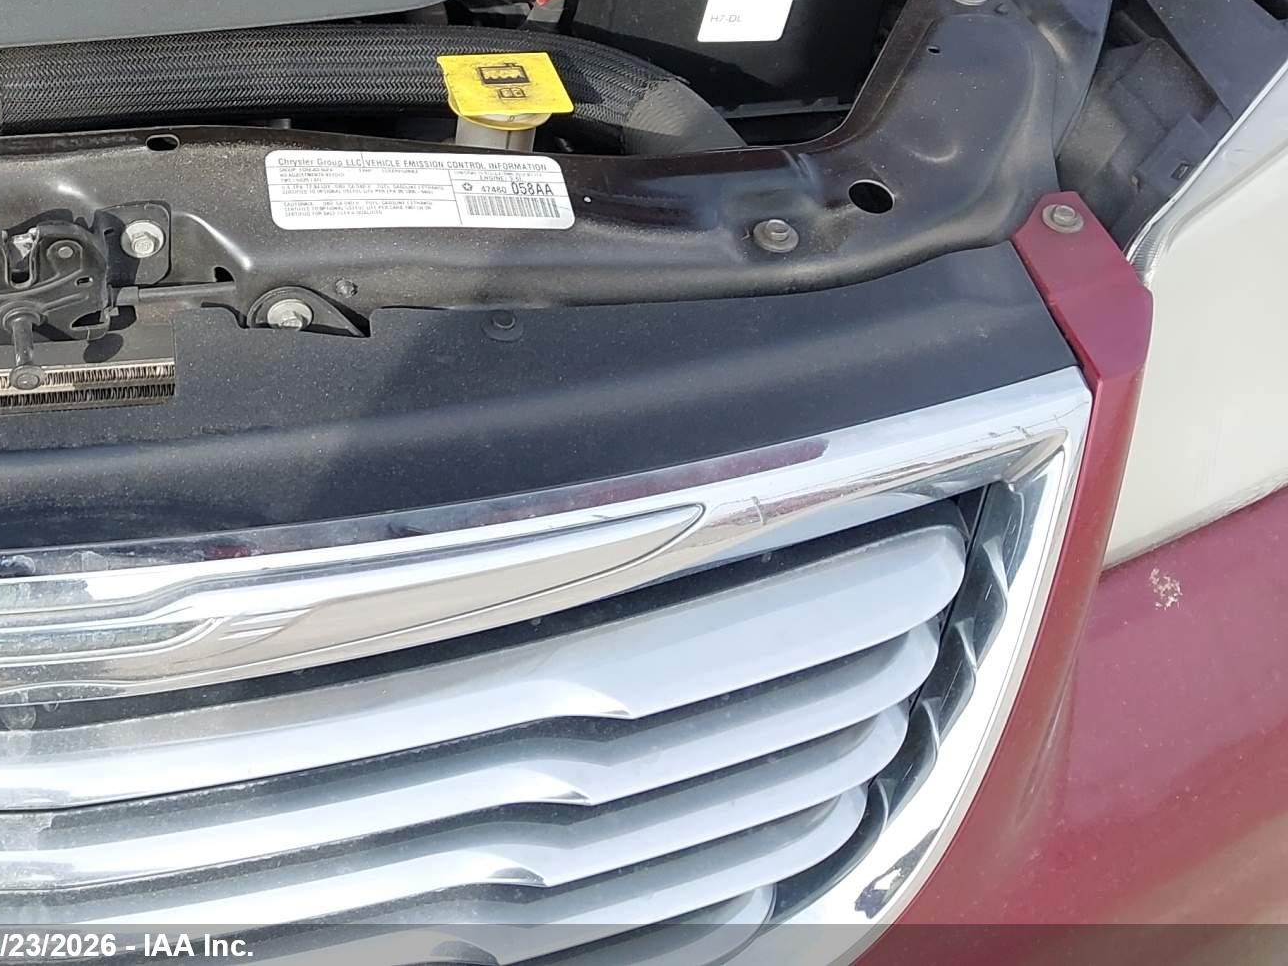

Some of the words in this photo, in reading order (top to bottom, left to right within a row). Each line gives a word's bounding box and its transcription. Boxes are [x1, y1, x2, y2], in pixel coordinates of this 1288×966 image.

[278, 158, 314, 167] Chrysler
[317, 158, 343, 168] Group
[346, 159, 361, 167] LLC
[364, 159, 401, 168] VEHICLE
[403, 160, 444, 169] EMISSION
[447, 161, 487, 170] CONTROL
[488, 162, 548, 172] INFORMATION
[511, 181, 554, 196] 058AA
